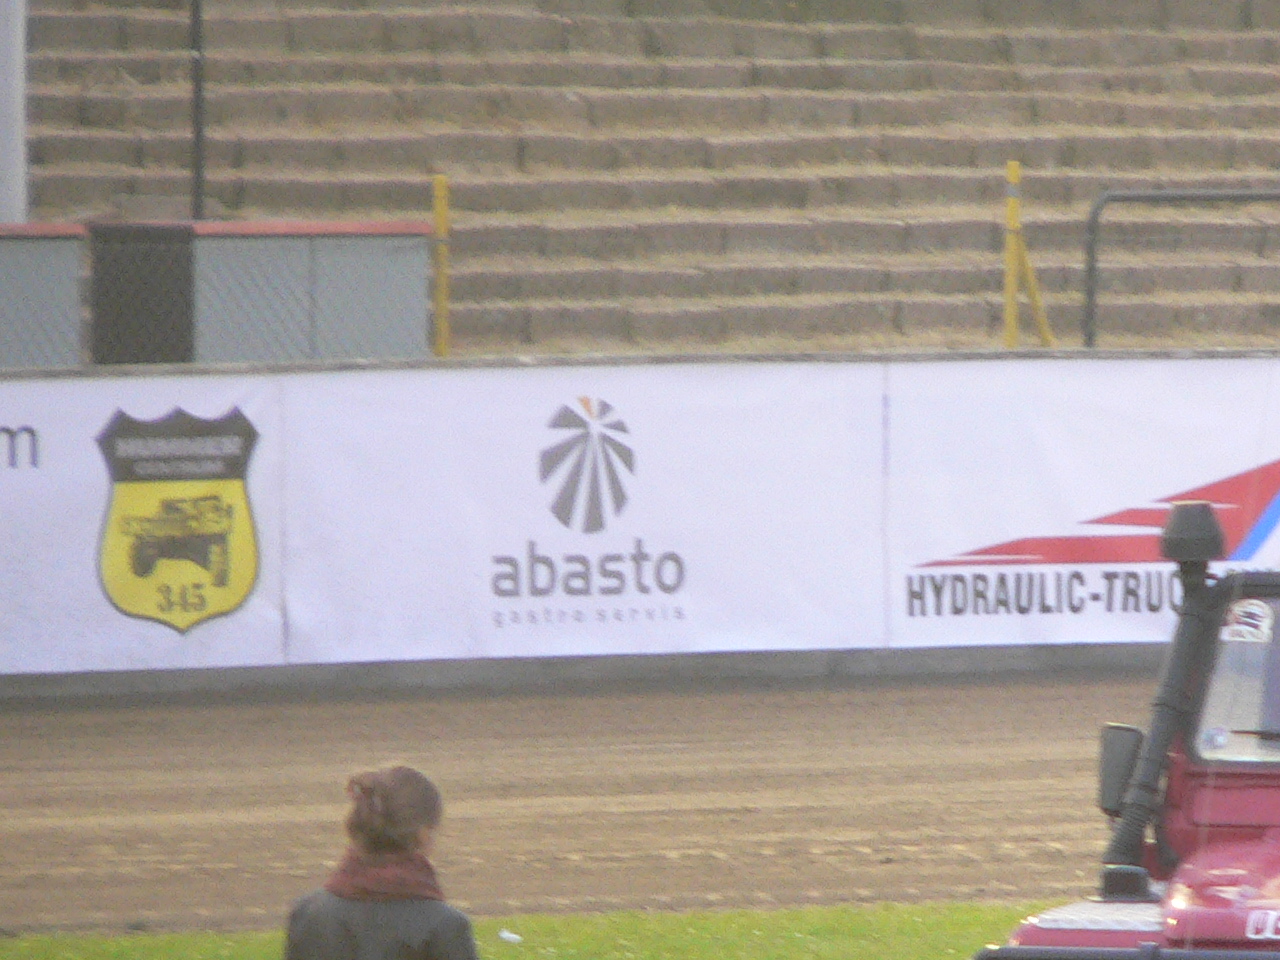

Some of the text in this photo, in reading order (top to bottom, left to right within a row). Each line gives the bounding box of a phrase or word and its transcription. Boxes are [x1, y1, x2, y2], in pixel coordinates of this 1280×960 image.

[491, 537, 685, 597] abasto
[157, 583, 207, 612] 345
[905, 570, 1185, 617] HYDRAULIC-TRUC
